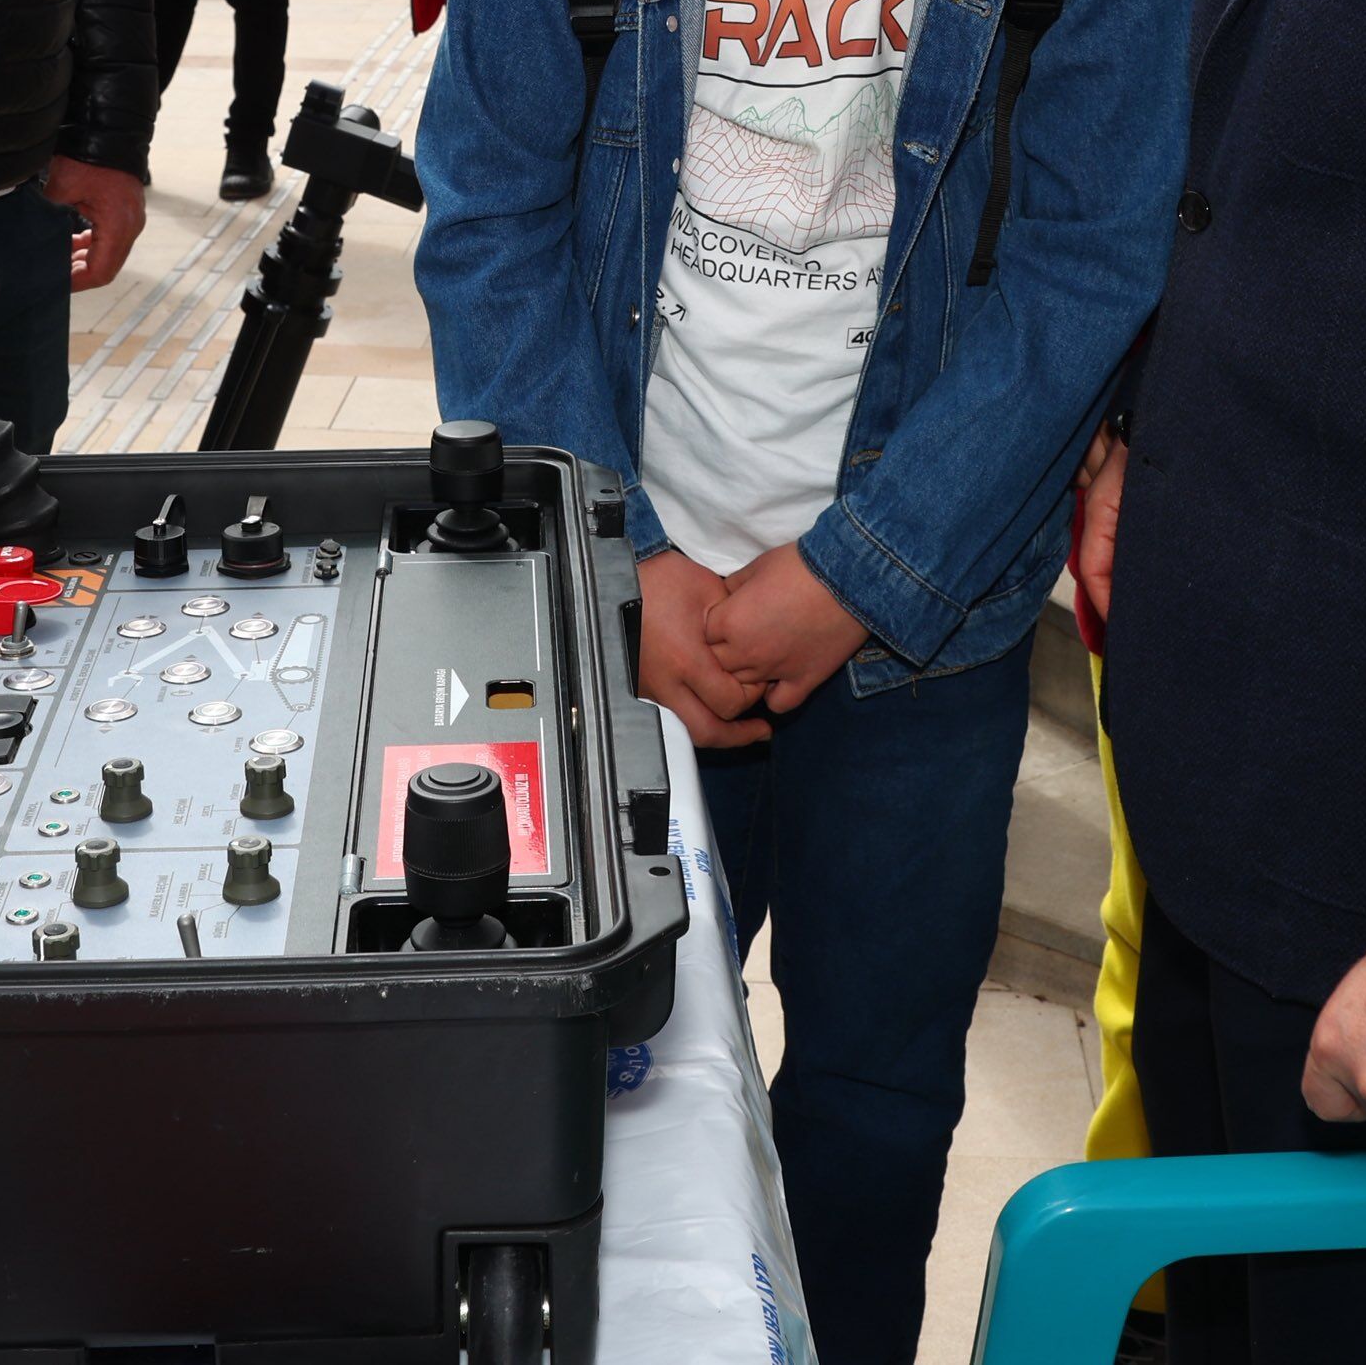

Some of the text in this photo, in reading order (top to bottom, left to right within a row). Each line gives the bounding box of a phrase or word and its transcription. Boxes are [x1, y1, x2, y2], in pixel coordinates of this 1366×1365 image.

[671, 237, 857, 291] HEADQUARTERS
[149, 893, 163, 918] KAMERA
[618, 1046, 647, 1084] OLİS
